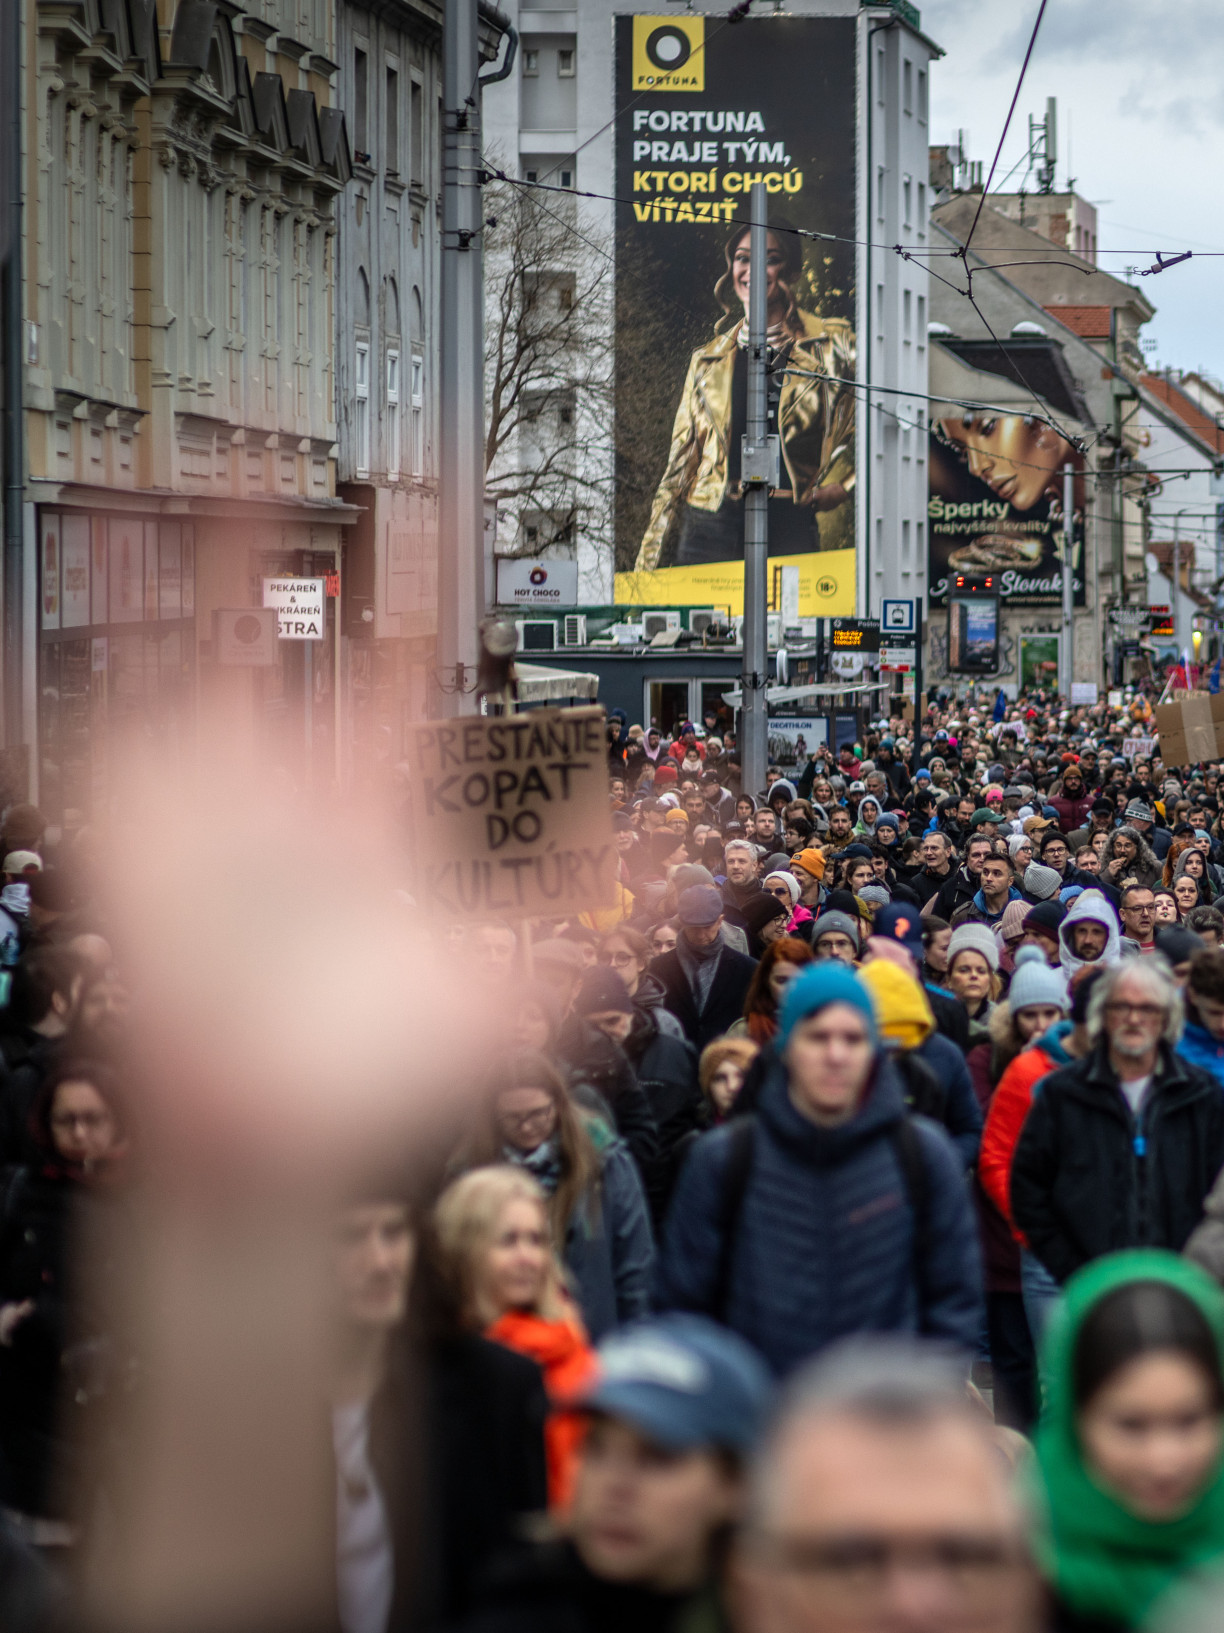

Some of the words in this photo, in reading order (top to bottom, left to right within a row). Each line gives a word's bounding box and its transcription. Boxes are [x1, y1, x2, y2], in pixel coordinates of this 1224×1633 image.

[633, 110, 766, 133] FORTUNA
[633, 140, 718, 163] PRAJE
[722, 137, 791, 167] TÝM,
[633, 167, 717, 192] KTORÍ
[722, 167, 803, 193] CHCÚ
[633, 197, 738, 223] VÍŤAZIŤ
[928, 495, 1010, 520] Šperky
[933, 521, 999, 534] najvyššej
[1003, 520, 1050, 533] kvality
[270, 582, 317, 593] PEKÁREŇ
[998, 569, 1083, 596] Slovaka
[289, 595, 296, 603] &
[514, 588, 531, 597] HOT
[532, 588, 560, 597] CHOCO
[278, 604, 321, 615] KRÁREŇ
[857, 619, 880, 628] Poštov
[770, 721, 812, 729] DECATHLON
[486, 809, 542, 851] DO
